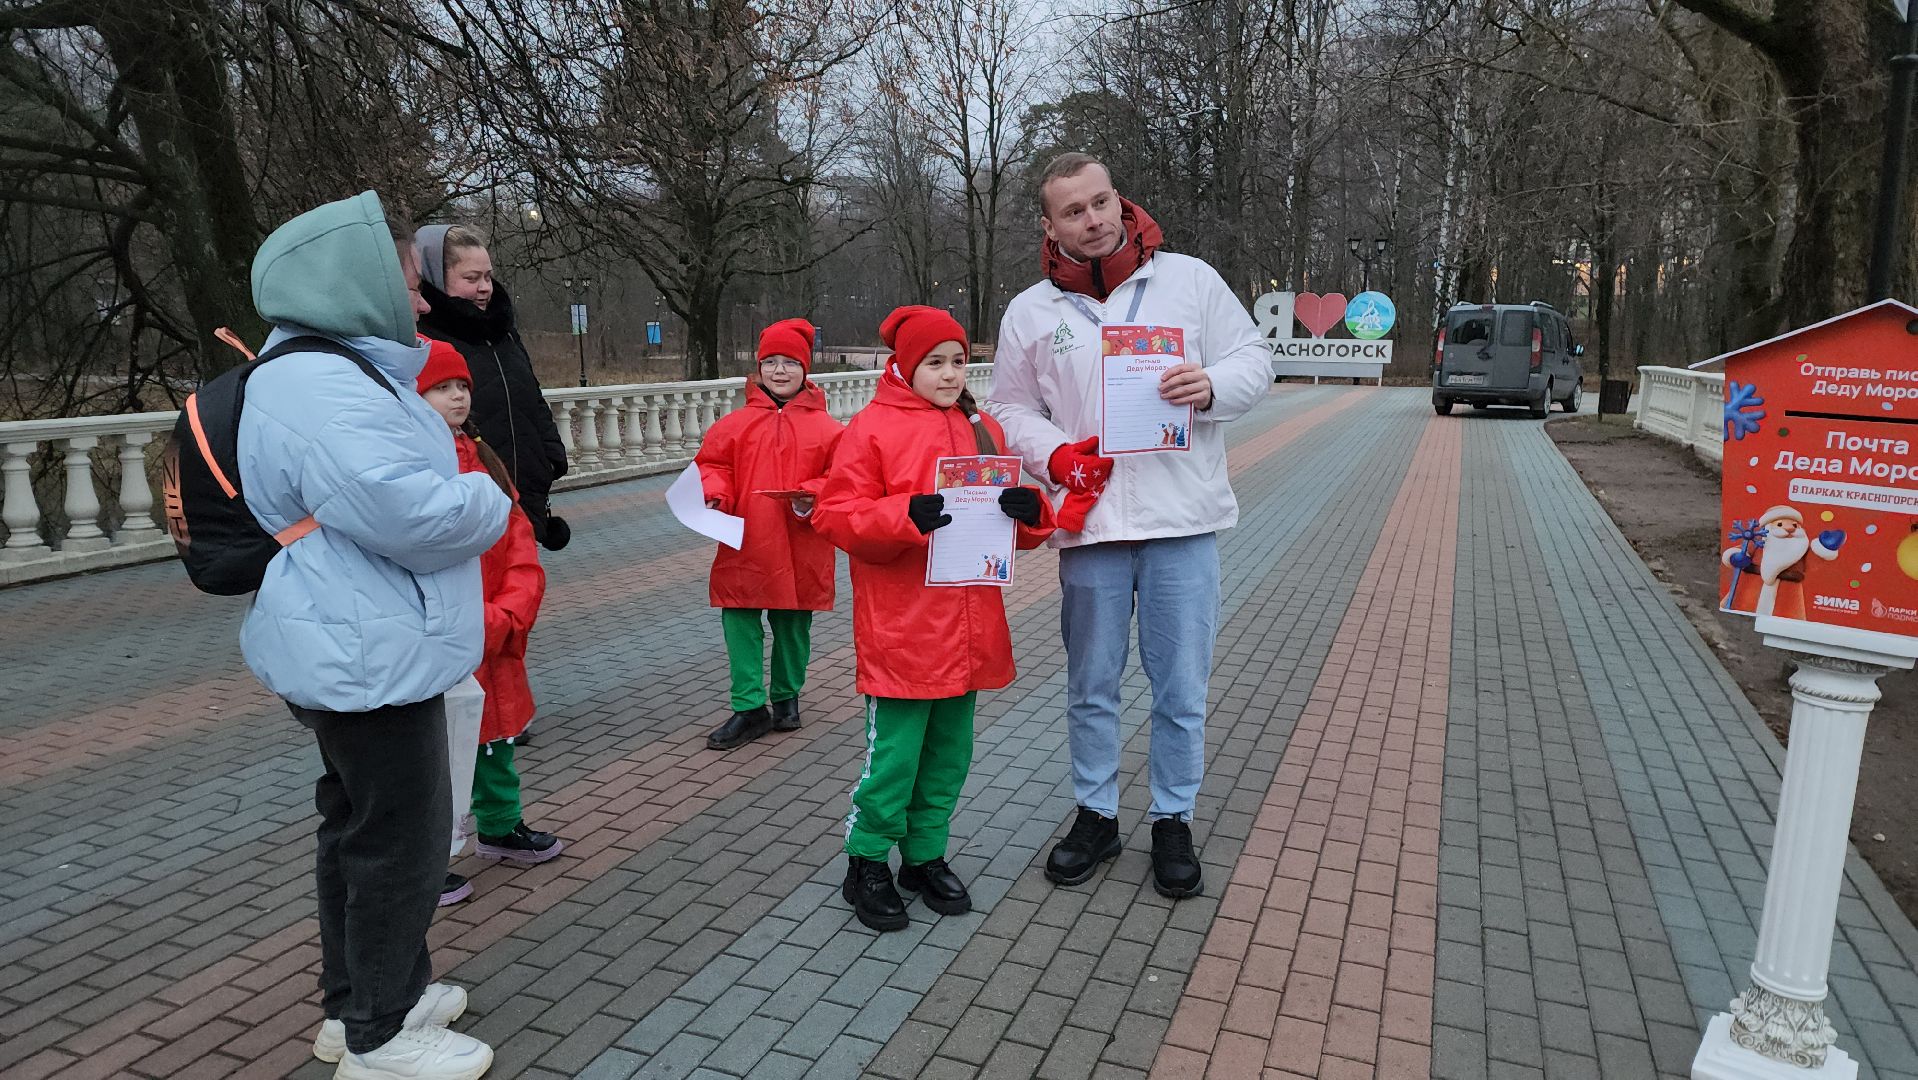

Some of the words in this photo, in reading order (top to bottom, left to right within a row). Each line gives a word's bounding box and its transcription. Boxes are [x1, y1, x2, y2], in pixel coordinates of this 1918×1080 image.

[1253, 291, 1295, 339] Я
[1126, 365, 1143, 373] Деду
[1800, 363, 1881, 380] Отправь
[1885, 369, 1918, 382] пис
[1811, 380, 1862, 399] Деду
[1866, 383, 1918, 401] Моро
[1826, 431, 1909, 455] Почта
[1774, 451, 1842, 474] Деда
[1849, 456, 1918, 483] Моро
[1791, 485, 1799, 494] В
[1801, 485, 1844, 499] ПАРКАХ
[1888, 606, 1917, 616] ПАРКИ
